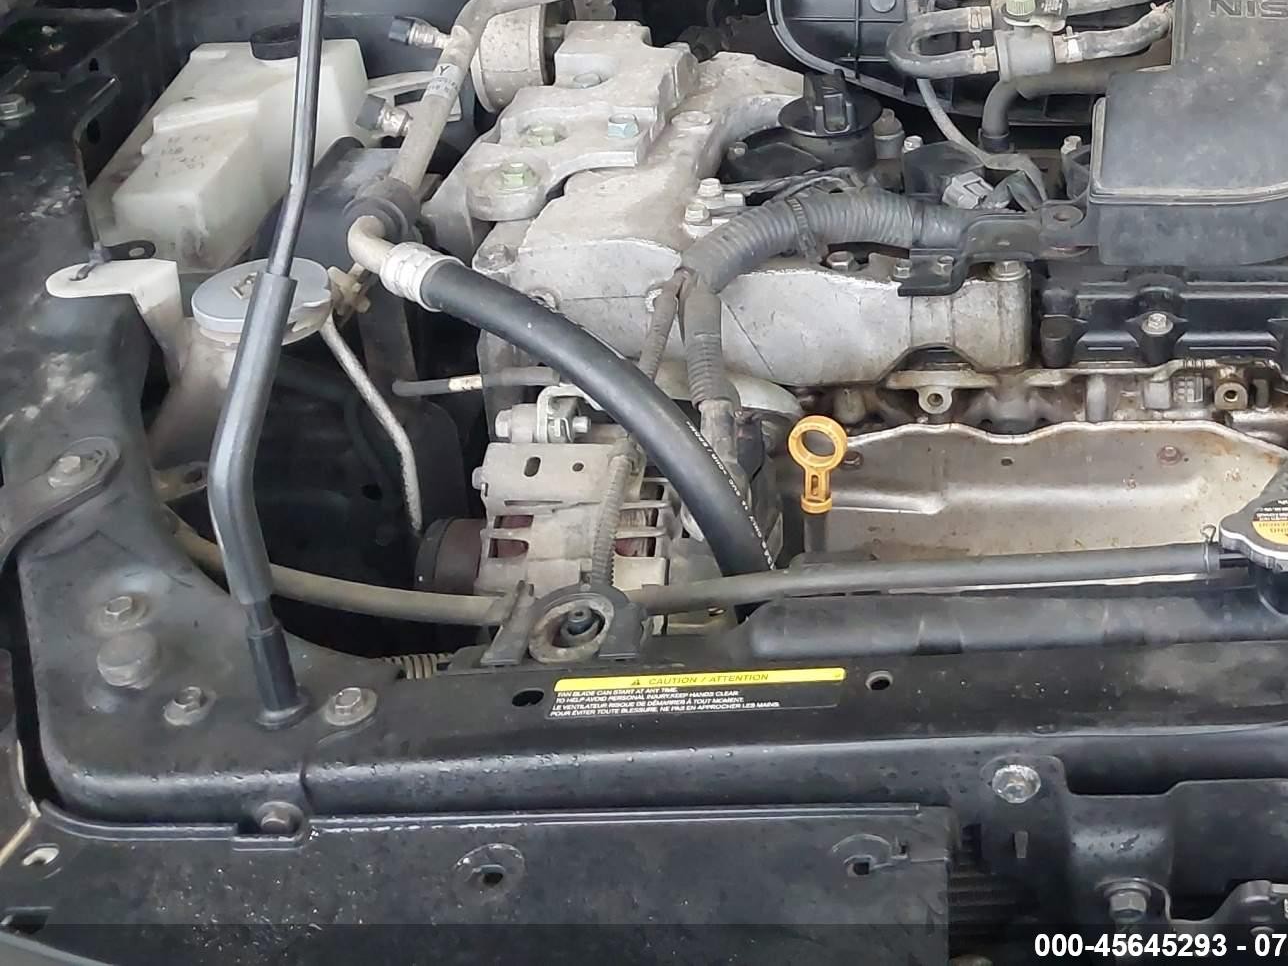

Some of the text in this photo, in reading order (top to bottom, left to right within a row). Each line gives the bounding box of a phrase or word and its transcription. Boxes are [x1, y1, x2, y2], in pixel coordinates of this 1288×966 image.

[649, 677, 698, 685] CAUTION
[708, 674, 769, 682] ATTENTION
[608, 694, 645, 702] PERSONAL
[597, 707, 620, 715] TOUTE
